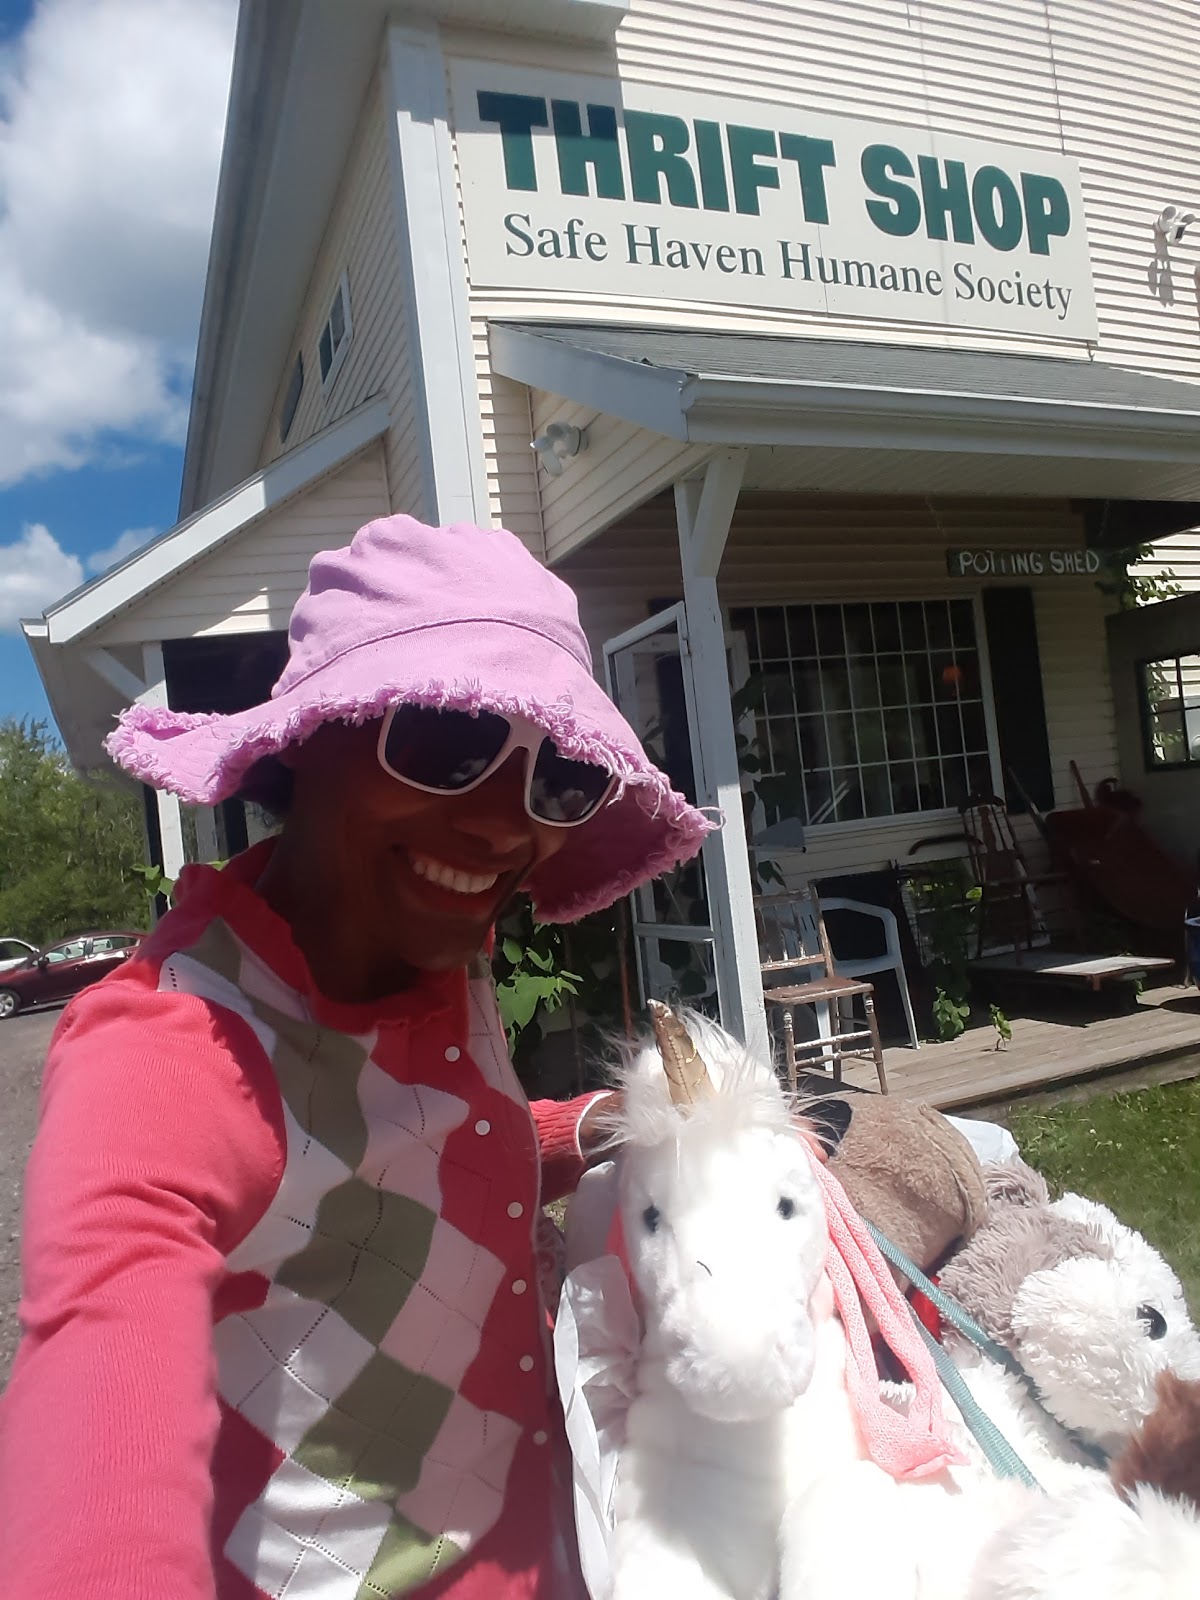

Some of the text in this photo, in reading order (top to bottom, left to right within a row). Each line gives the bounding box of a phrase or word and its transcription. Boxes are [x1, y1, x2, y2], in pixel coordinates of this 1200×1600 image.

[477, 90, 1071, 256] THRIFT SHOP
[504, 213, 1072, 320] Safe Haven Humane Society
[1050, 550, 1100, 573] SHED
